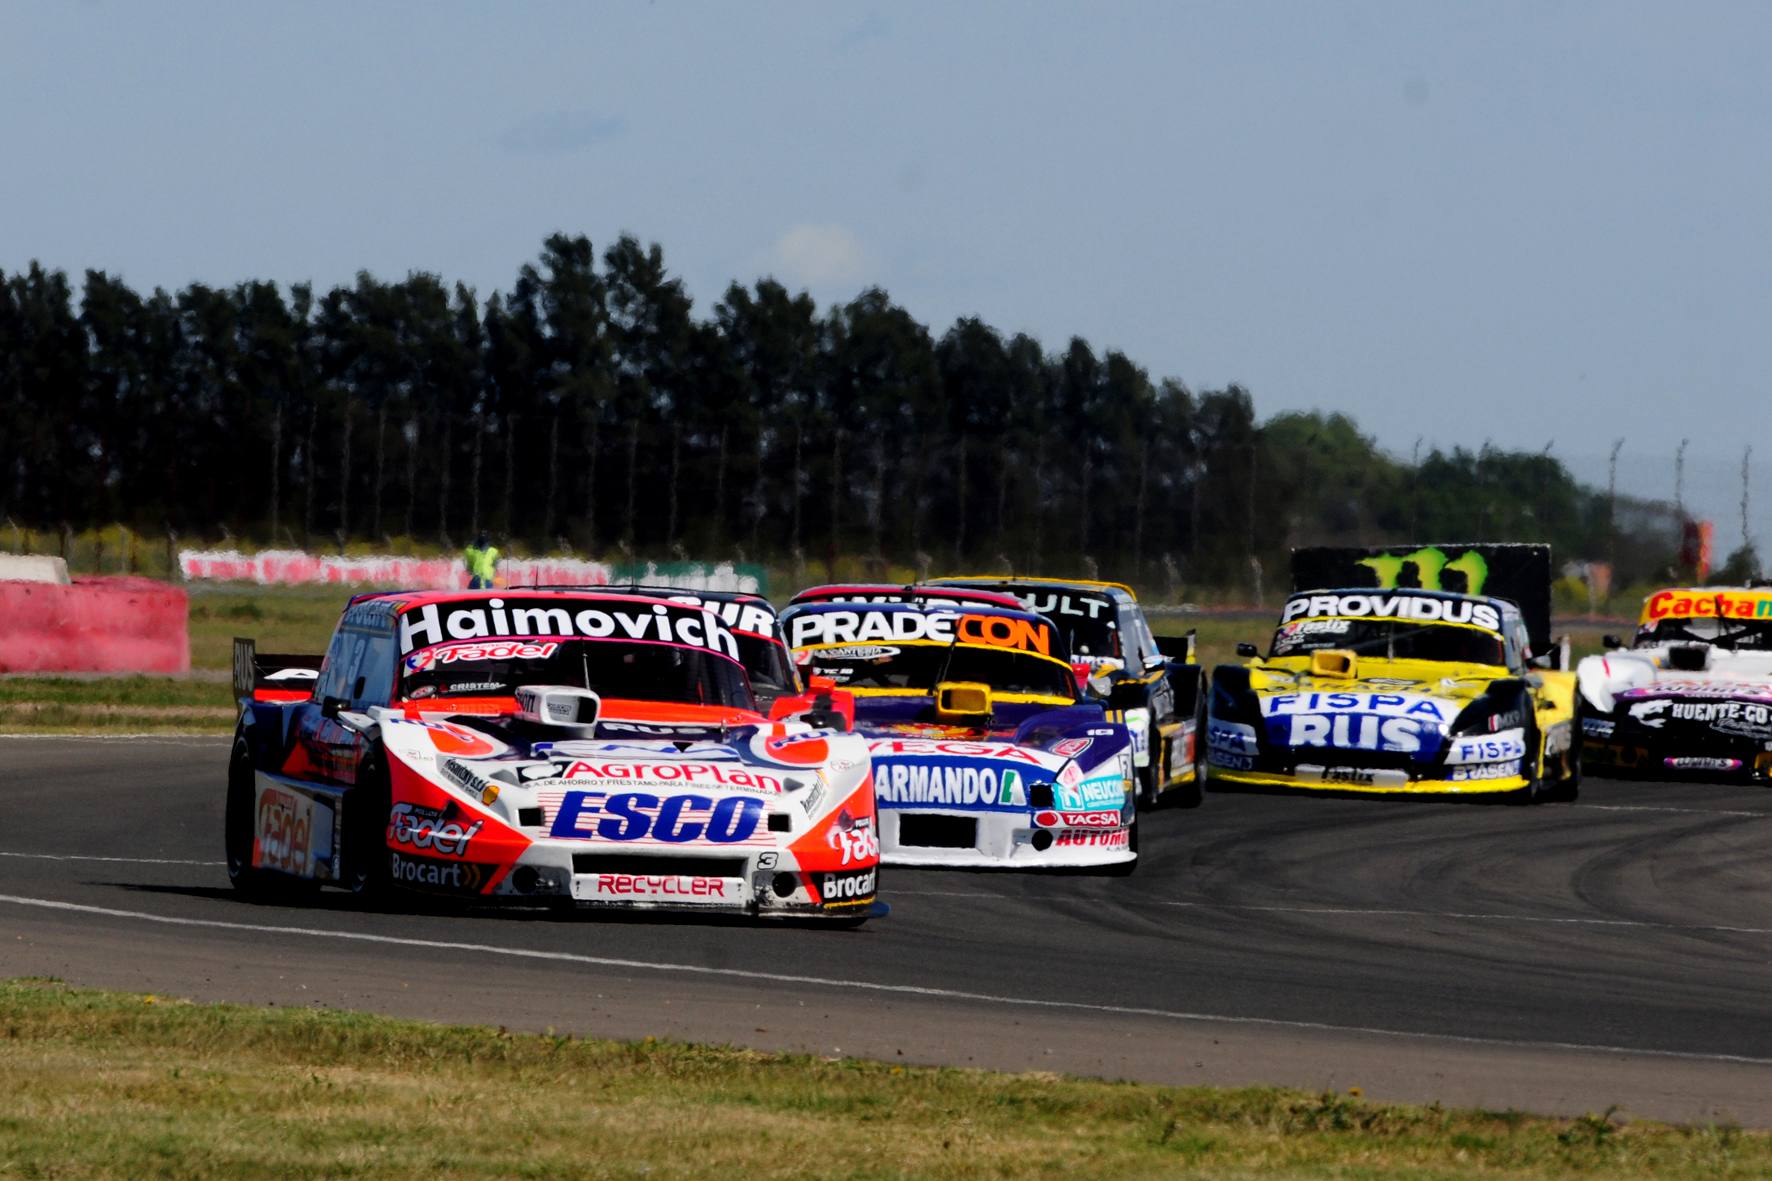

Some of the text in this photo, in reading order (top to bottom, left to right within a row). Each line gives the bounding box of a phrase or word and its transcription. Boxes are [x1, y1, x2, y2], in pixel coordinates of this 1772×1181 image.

[401, 598, 740, 662] Haimovich
[668, 596, 776, 638] UR
[1282, 595, 1499, 631] PROVIDUS
[436, 642, 558, 664] Fadel
[1270, 693, 1445, 721] FISPA
[1289, 715, 1421, 752] RUS
[875, 764, 998, 805] ARMANDO
[390, 803, 484, 855] Fadel
[549, 791, 764, 843] ESCO
[1066, 814, 1118, 826] TACSA
[391, 853, 461, 887] Brocart
[756, 851, 779, 870] 3
[597, 875, 725, 898] RECYCLER
